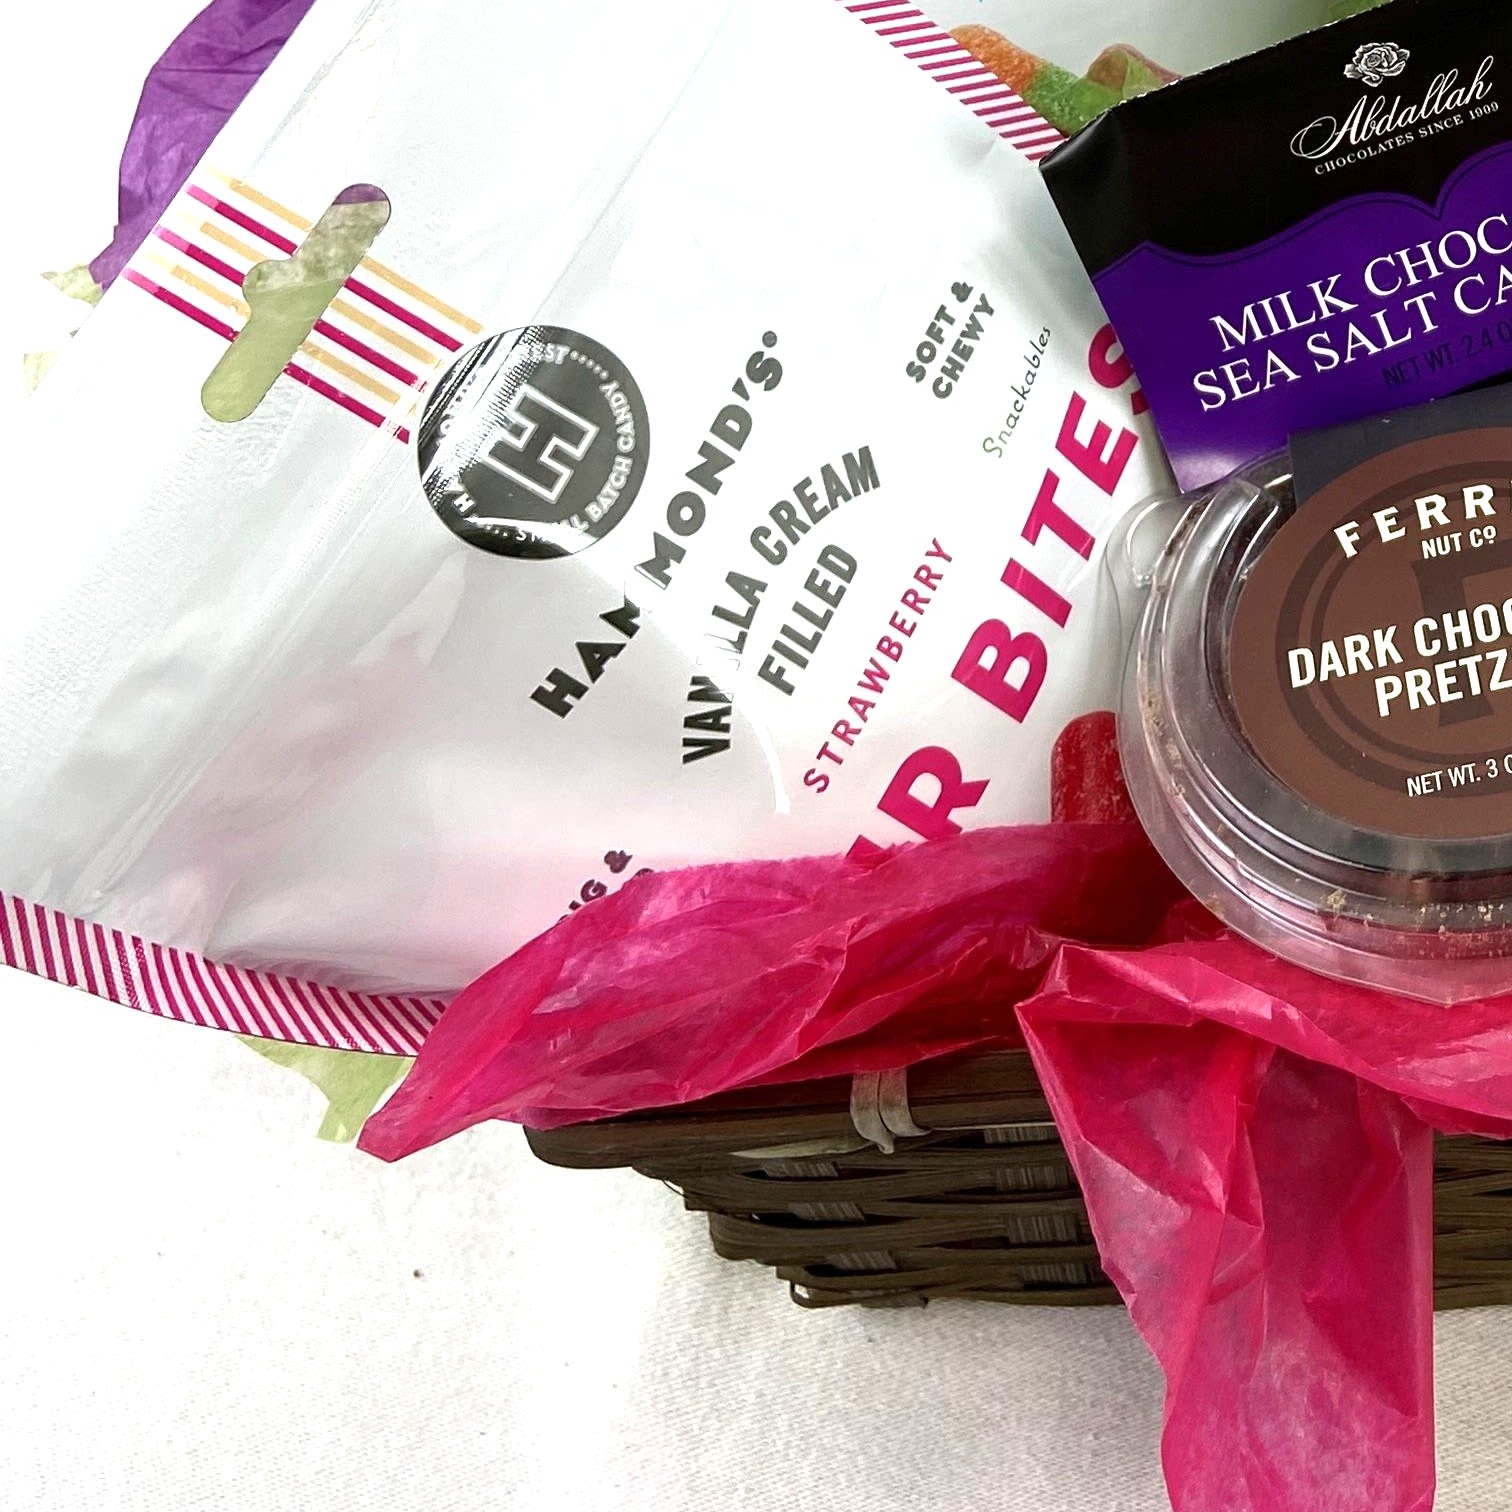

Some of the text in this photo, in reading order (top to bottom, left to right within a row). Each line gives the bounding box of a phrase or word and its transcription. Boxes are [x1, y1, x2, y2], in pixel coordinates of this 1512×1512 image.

[1289, 55, 1495, 159] Abdallah
[1314, 131, 1415, 176] CHOCOLATES
[1419, 114, 1464, 138] SINCE
[905, 281, 974, 384] SOFT &
[931, 292, 996, 400] CHEWY
[1192, 355, 1302, 412] SEA
[1313, 291, 1438, 375] SALT
[1210, 275, 1358, 353] MILK
[598, 379, 637, 454] CANDY
[982, 325, 1051, 459] Snackables
[1381, 357, 1421, 388] NET
[584, 455, 634, 523] BATCH
[1421, 531, 1463, 559] NUT
[682, 445, 881, 764] VANLLA CREAM
[757, 544, 858, 696] FILLED
[803, 537, 953, 794] STRAWBERRY
[1287, 624, 1403, 688] DARK
[1406, 771, 1443, 798] NET
[1448, 762, 1482, 790] WT.
[1486, 757, 1500, 781] 3
